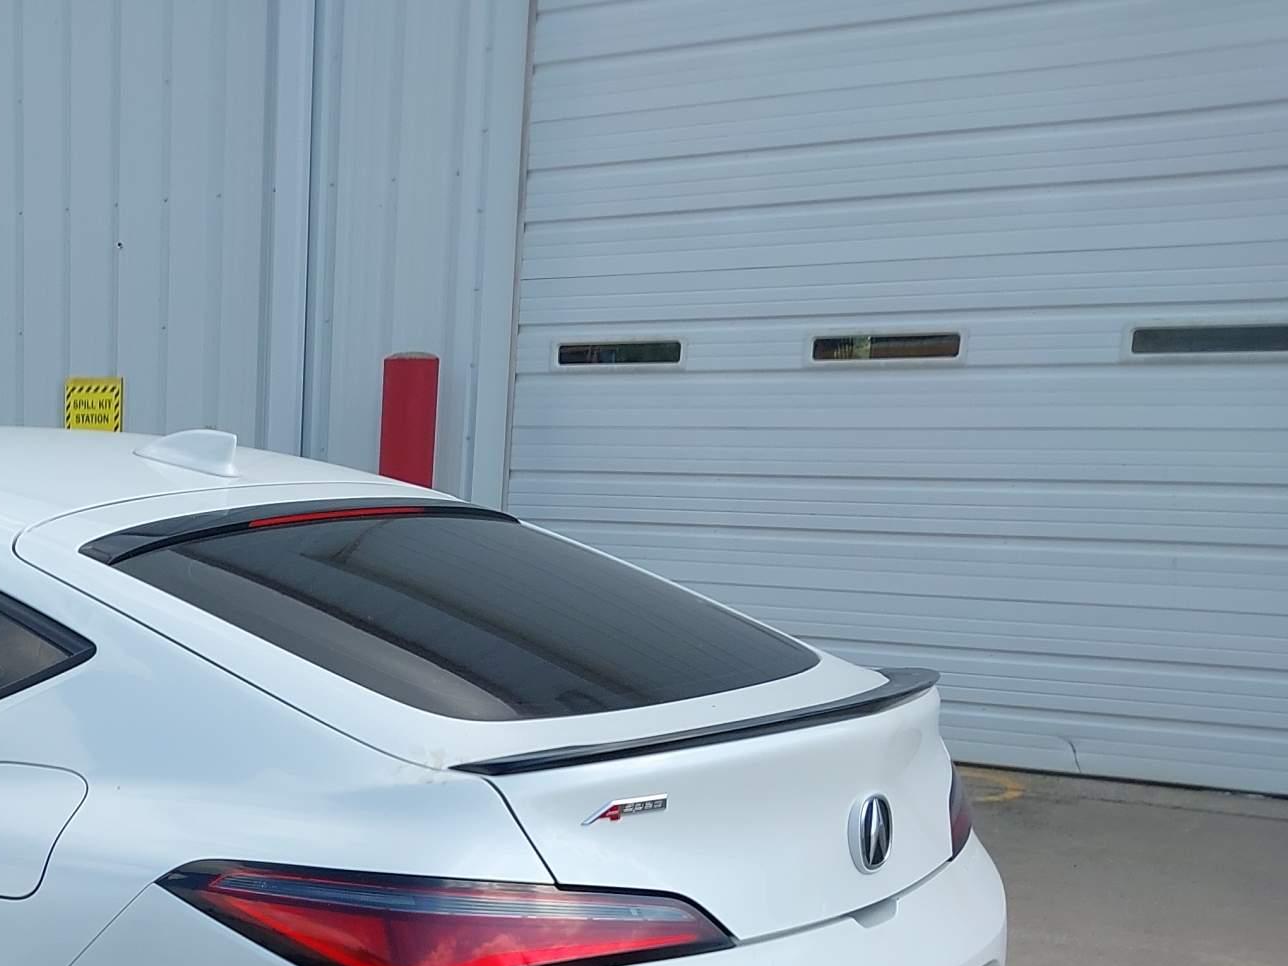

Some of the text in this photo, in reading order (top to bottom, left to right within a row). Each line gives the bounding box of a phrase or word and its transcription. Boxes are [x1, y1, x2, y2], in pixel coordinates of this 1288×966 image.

[73, 399, 112, 410] SPILL KIT
[75, 413, 110, 425] STATION
